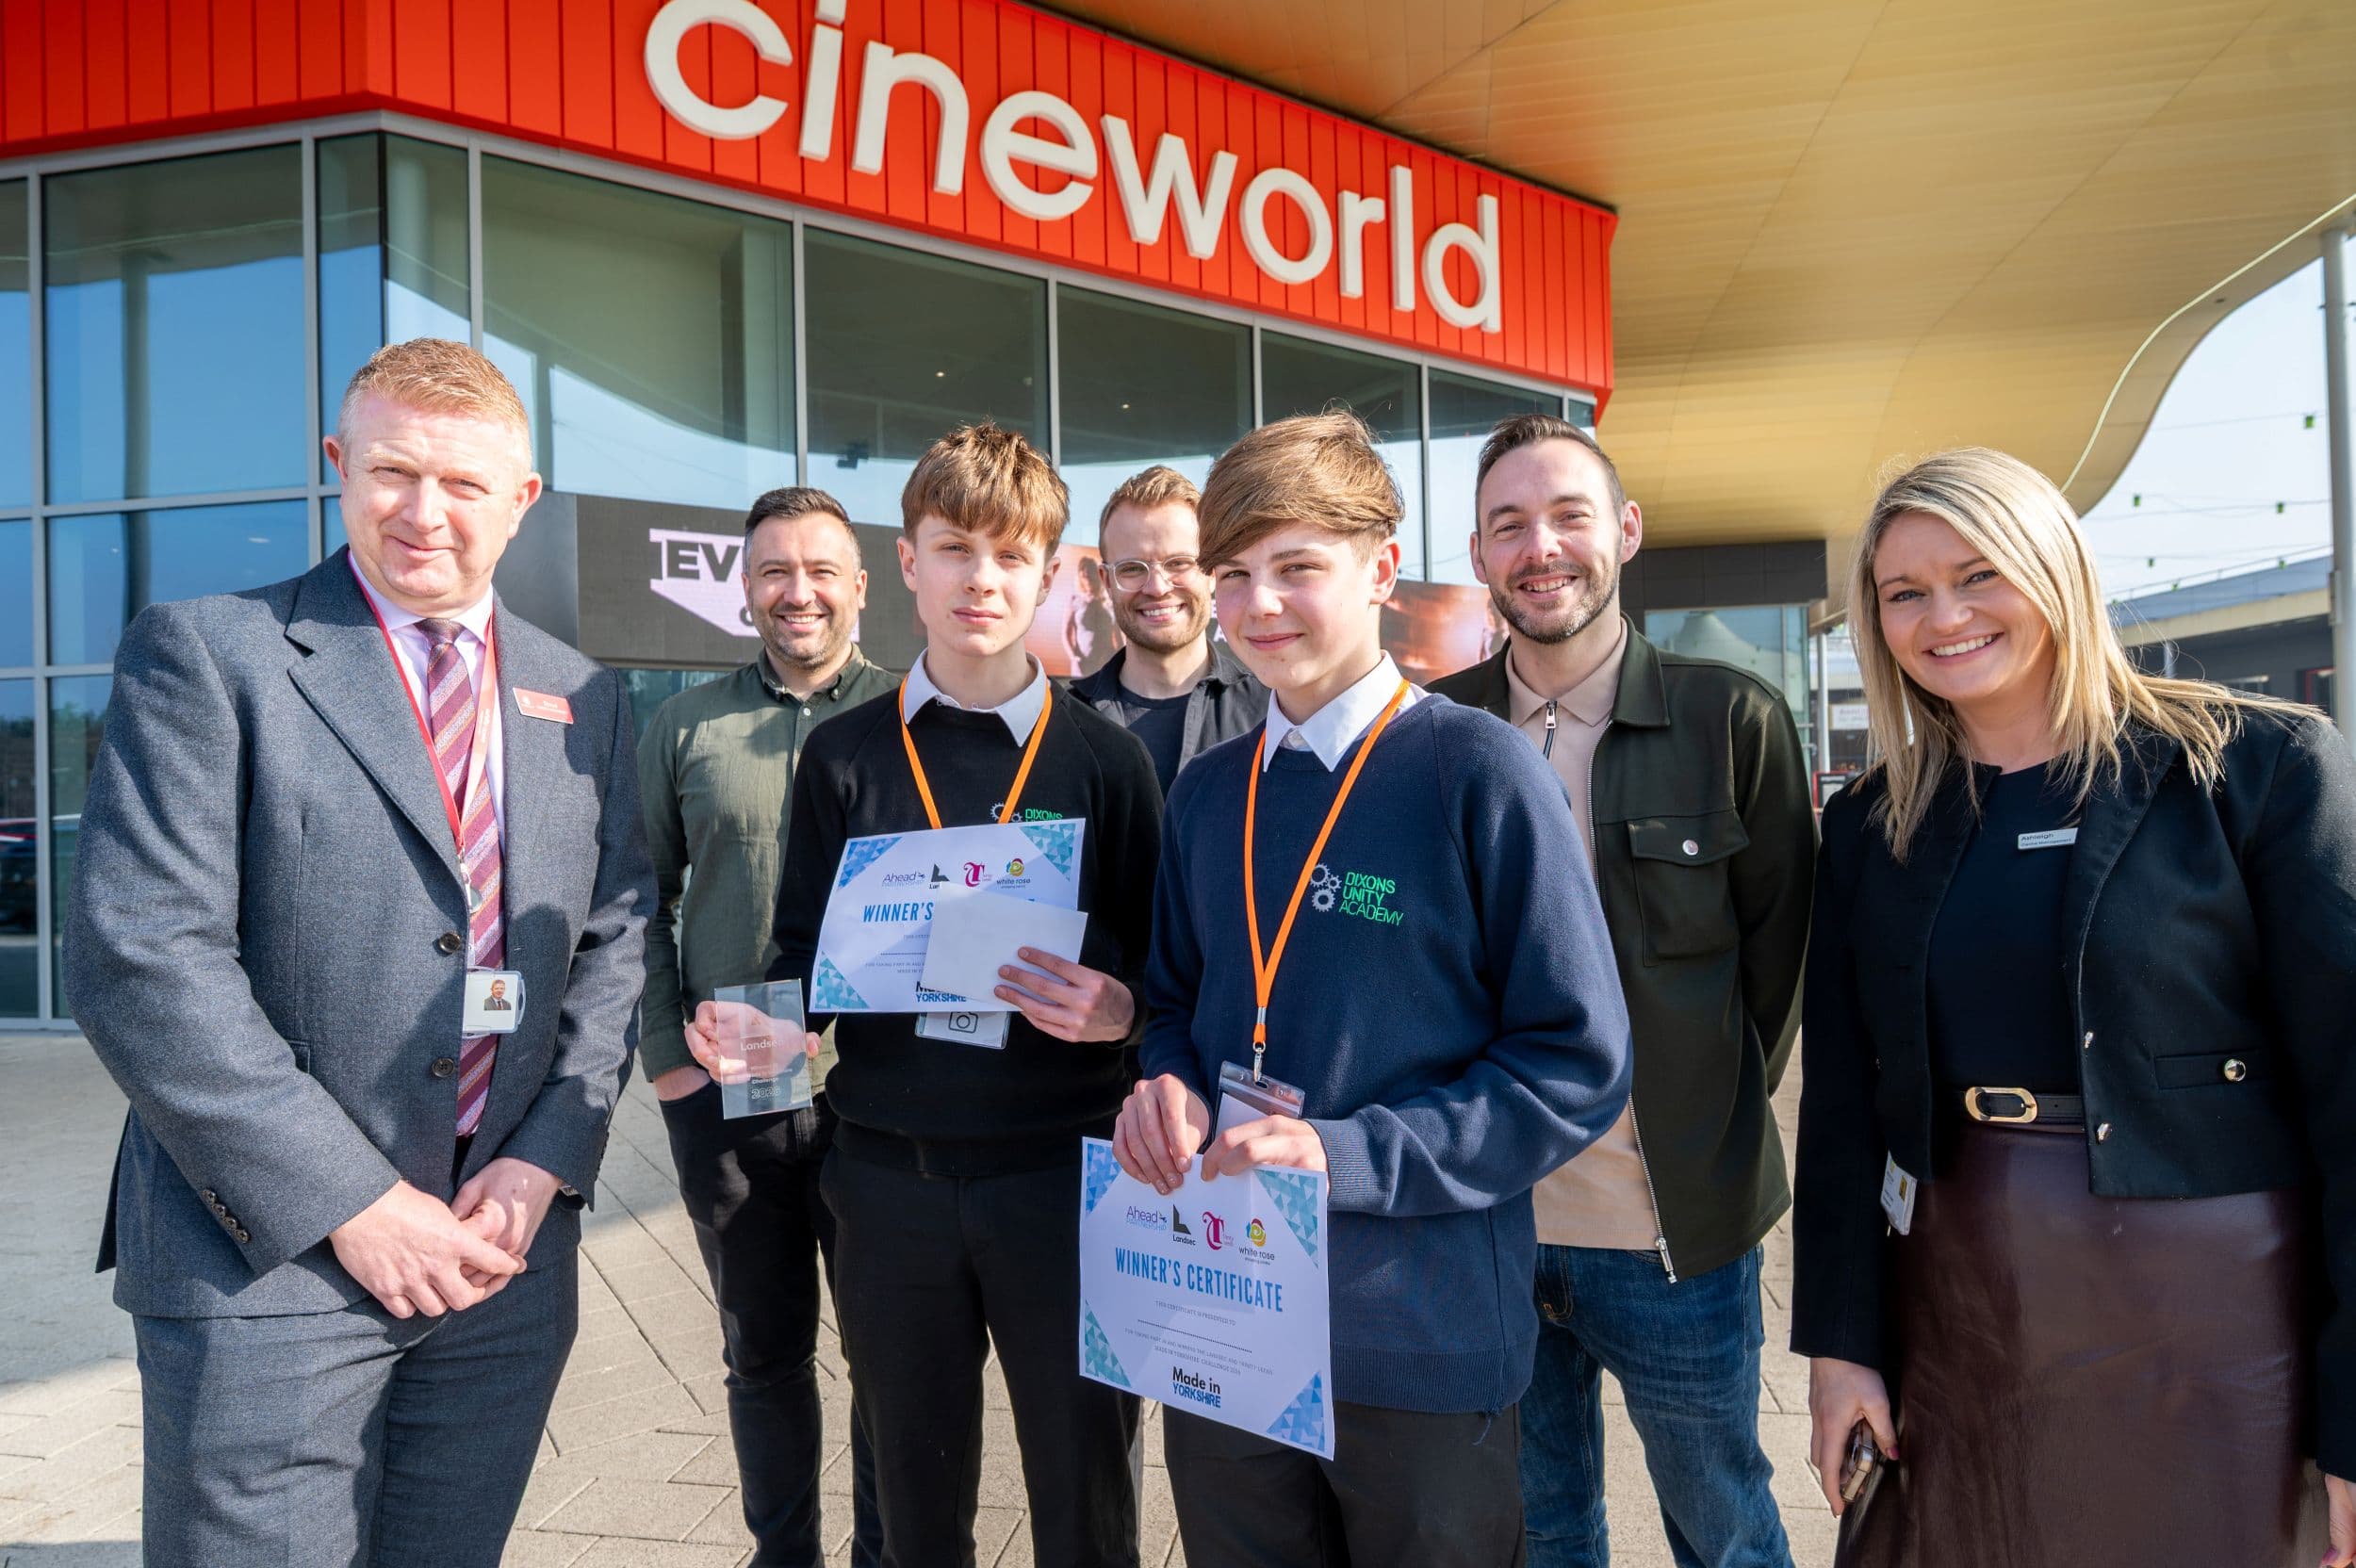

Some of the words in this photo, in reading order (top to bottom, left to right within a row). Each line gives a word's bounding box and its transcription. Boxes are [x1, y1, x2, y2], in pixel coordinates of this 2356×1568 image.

[644, 0, 1500, 334] cineworld
[883, 871, 917, 883] Ahead
[1345, 872, 1396, 894] DIXONS
[1343, 885, 1385, 906] UNITY
[863, 902, 935, 923] WINNER'S
[1338, 900, 1404, 925] ACADEMY
[1126, 1205, 1158, 1224] Ahead
[1172, 1233, 1197, 1246] Landsec
[1238, 1245, 1258, 1258] white
[1259, 1250, 1275, 1261] rose
[1116, 1247, 1182, 1287] WINNER'S
[1187, 1264, 1284, 1313] CERTIFICATE
[1172, 1365, 1206, 1391] Made
[1208, 1377, 1221, 1395] in
[1172, 1381, 1221, 1409] YORKSHIRE
